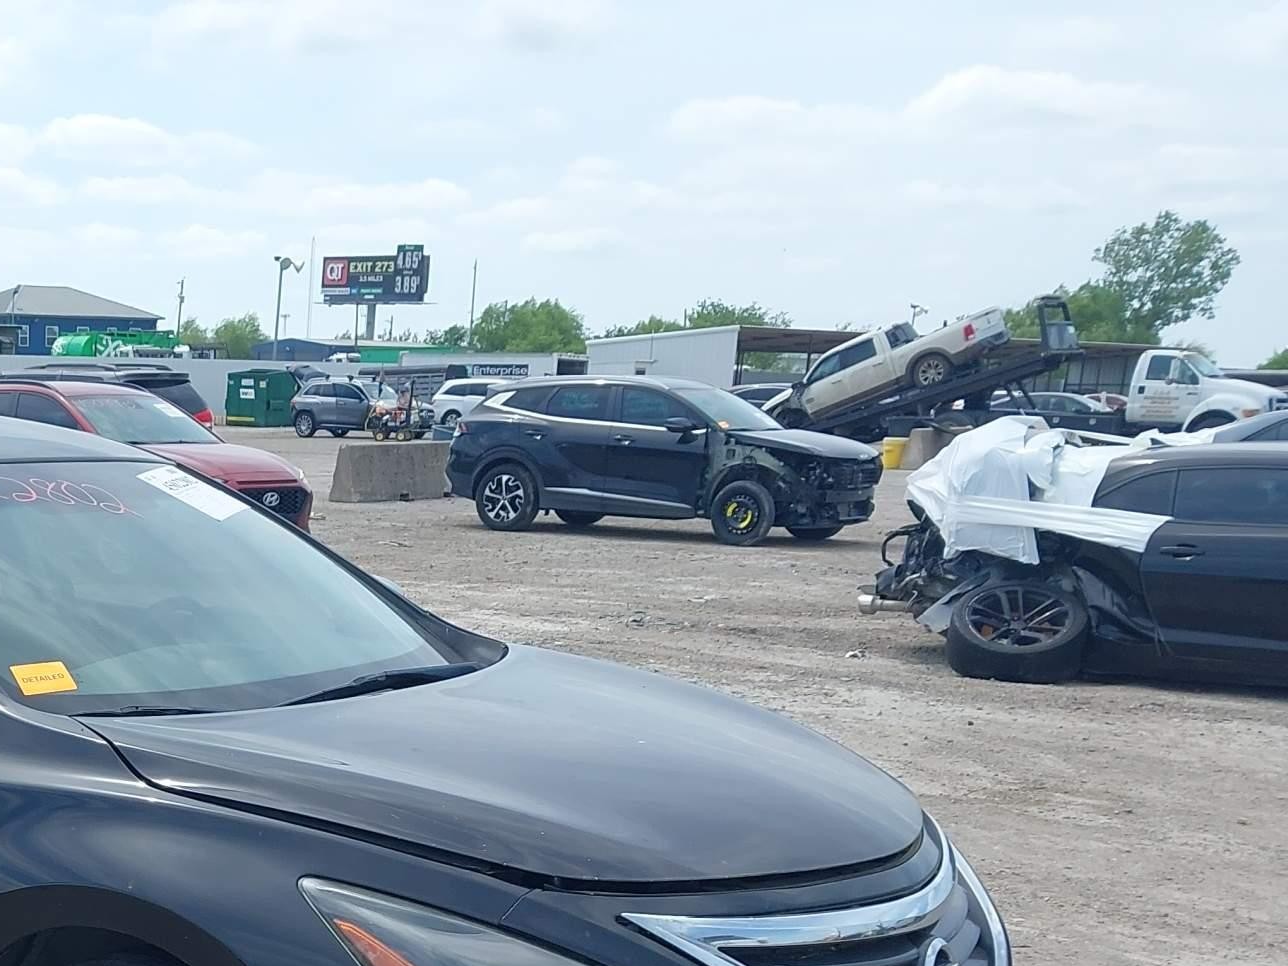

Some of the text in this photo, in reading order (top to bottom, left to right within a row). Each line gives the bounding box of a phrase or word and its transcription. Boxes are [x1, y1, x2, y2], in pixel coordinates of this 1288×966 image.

[327, 263, 344, 281] QT
[349, 261, 373, 273] EXIT
[374, 261, 395, 273] 273
[473, 365, 527, 377] Enterprise
[22, 673, 65, 684] DETAILED
